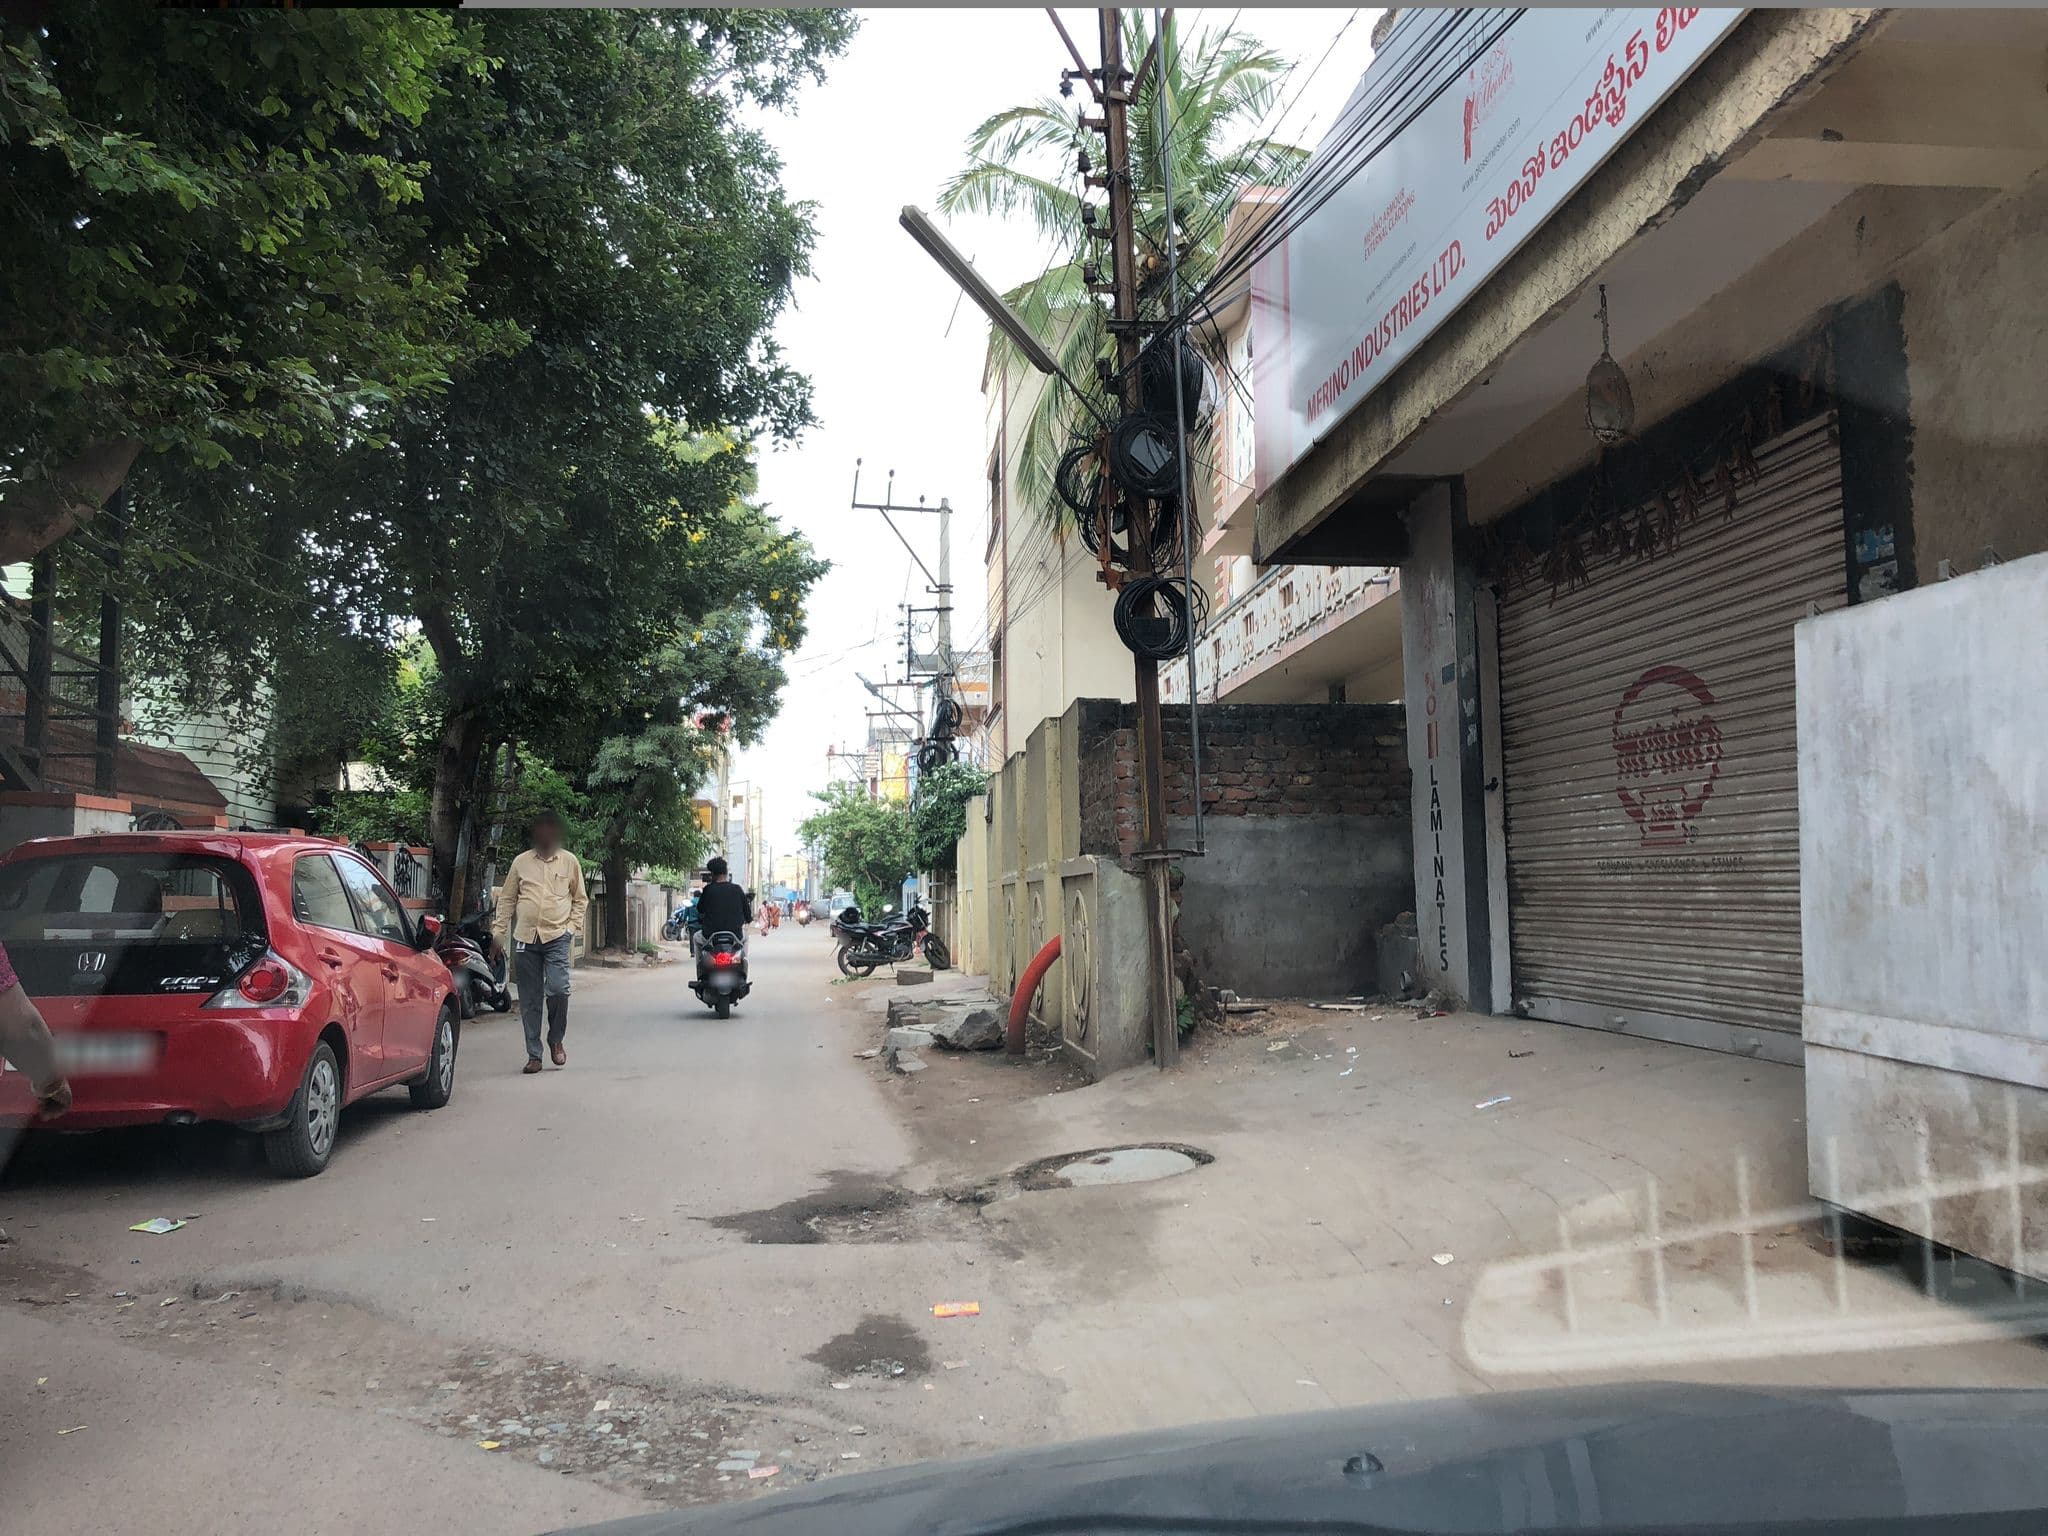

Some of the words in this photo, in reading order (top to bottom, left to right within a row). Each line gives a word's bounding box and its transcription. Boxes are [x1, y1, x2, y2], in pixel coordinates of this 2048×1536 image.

[1307, 359, 1350, 427] MERINO
[1351, 271, 1430, 381] INDUSTRIES
[1432, 239, 1466, 298] LTD.
[1430, 764, 1449, 972] LAMINATES
